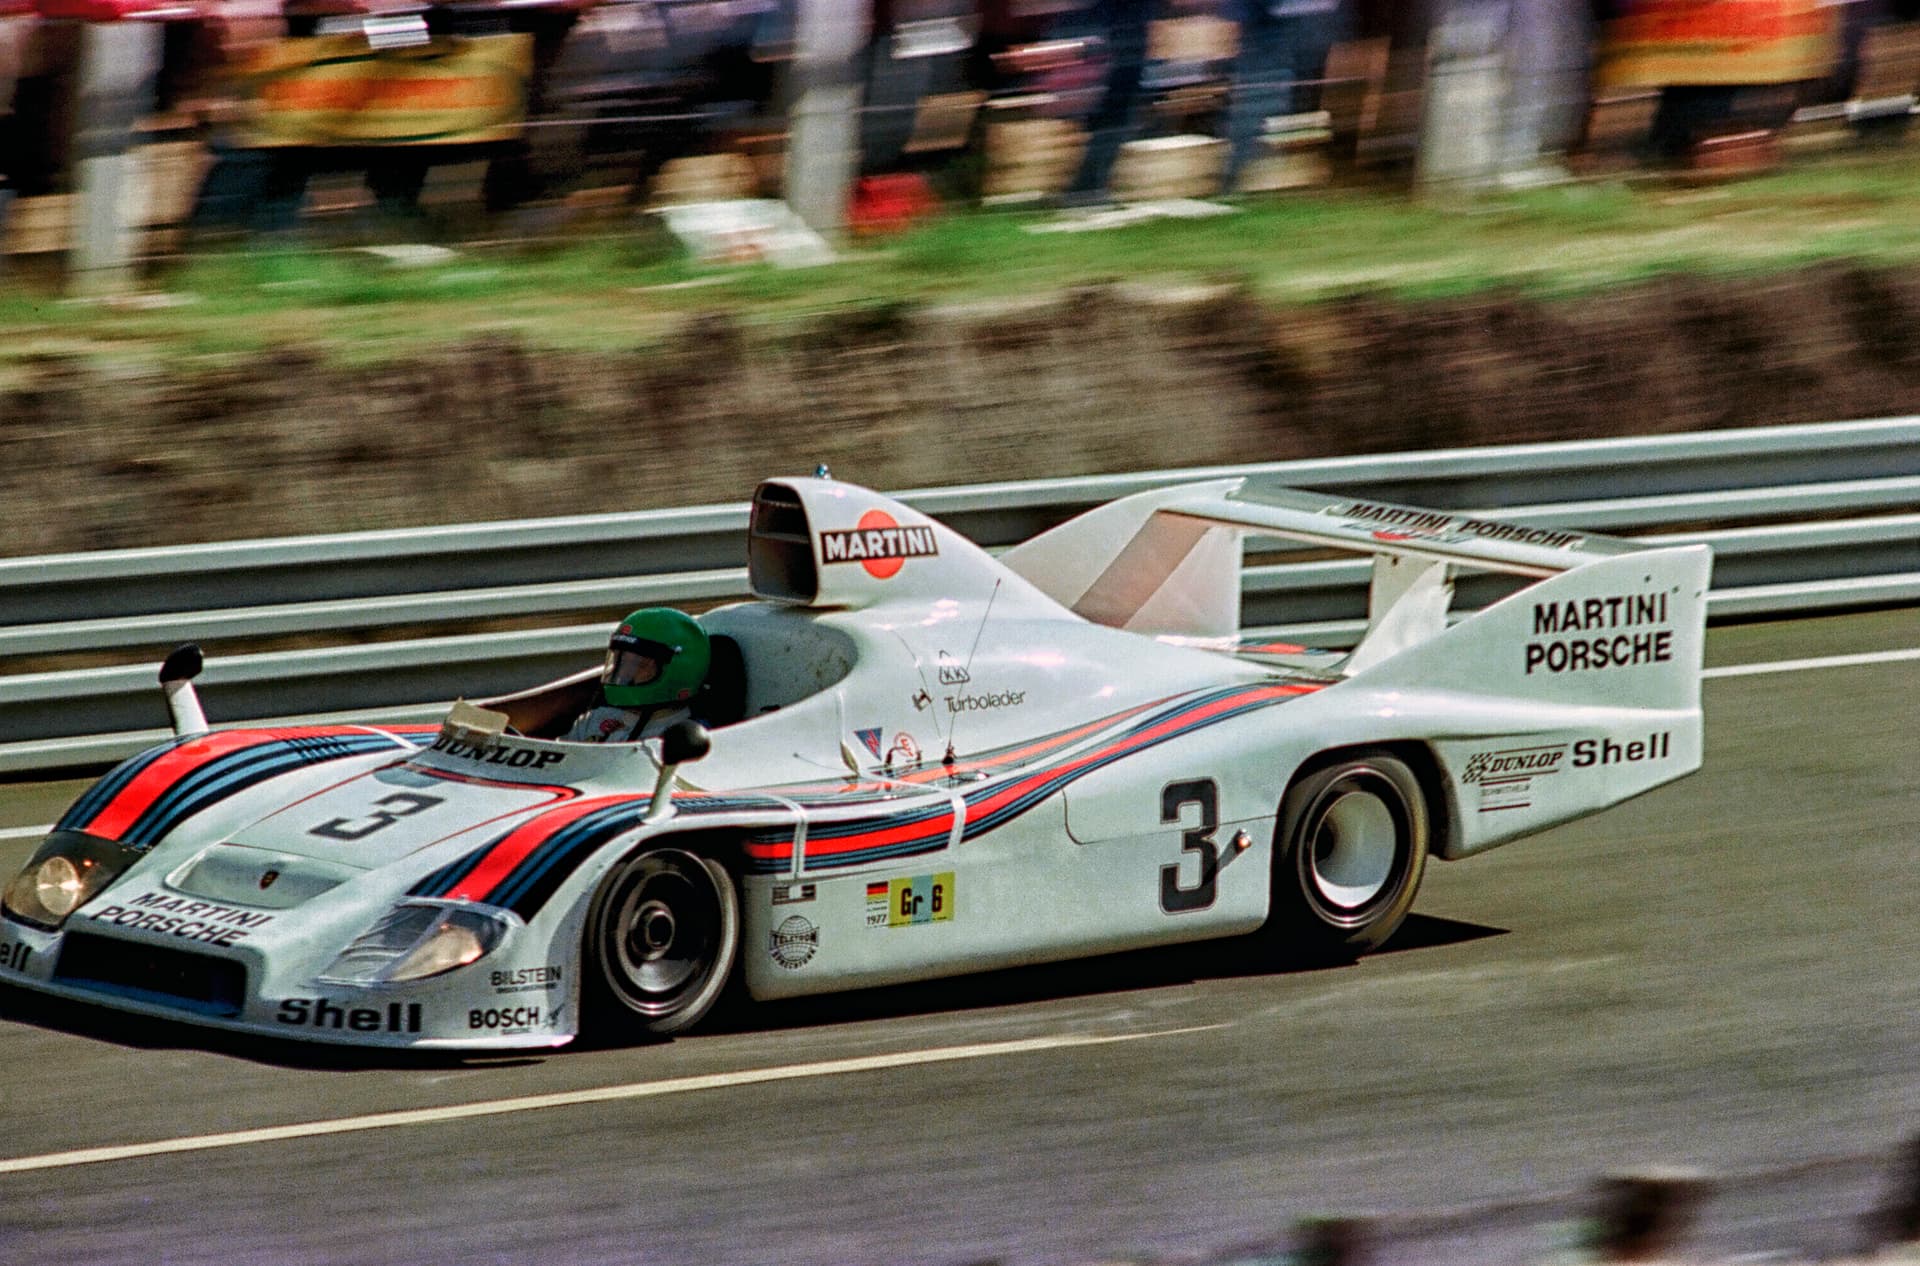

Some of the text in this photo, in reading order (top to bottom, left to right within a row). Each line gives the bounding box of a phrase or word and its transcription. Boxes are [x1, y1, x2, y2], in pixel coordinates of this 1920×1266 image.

[1345, 503, 1454, 530] MARTINI
[823, 526, 937, 561] MARTINI
[1533, 591, 1668, 635] MARTINI
[1525, 630, 1674, 674] PORSCHE
[944, 690, 1026, 713] Turbolader
[428, 738, 566, 769] DUNLOP
[1489, 751, 1564, 773] DUNLOP
[1572, 732, 1670, 767] Shell
[308, 792, 447, 841] 3
[1159, 777, 1219, 914] 3
[129, 893, 274, 928] MARTINI
[901, 884, 943, 916] Gr 6
[90, 905, 250, 947] PORSCHE
[866, 914, 887, 925] 1977
[491, 966, 562, 986] BILSTEIN
[276, 998, 422, 1033] Shell
[469, 1007, 539, 1029] BOSCH
